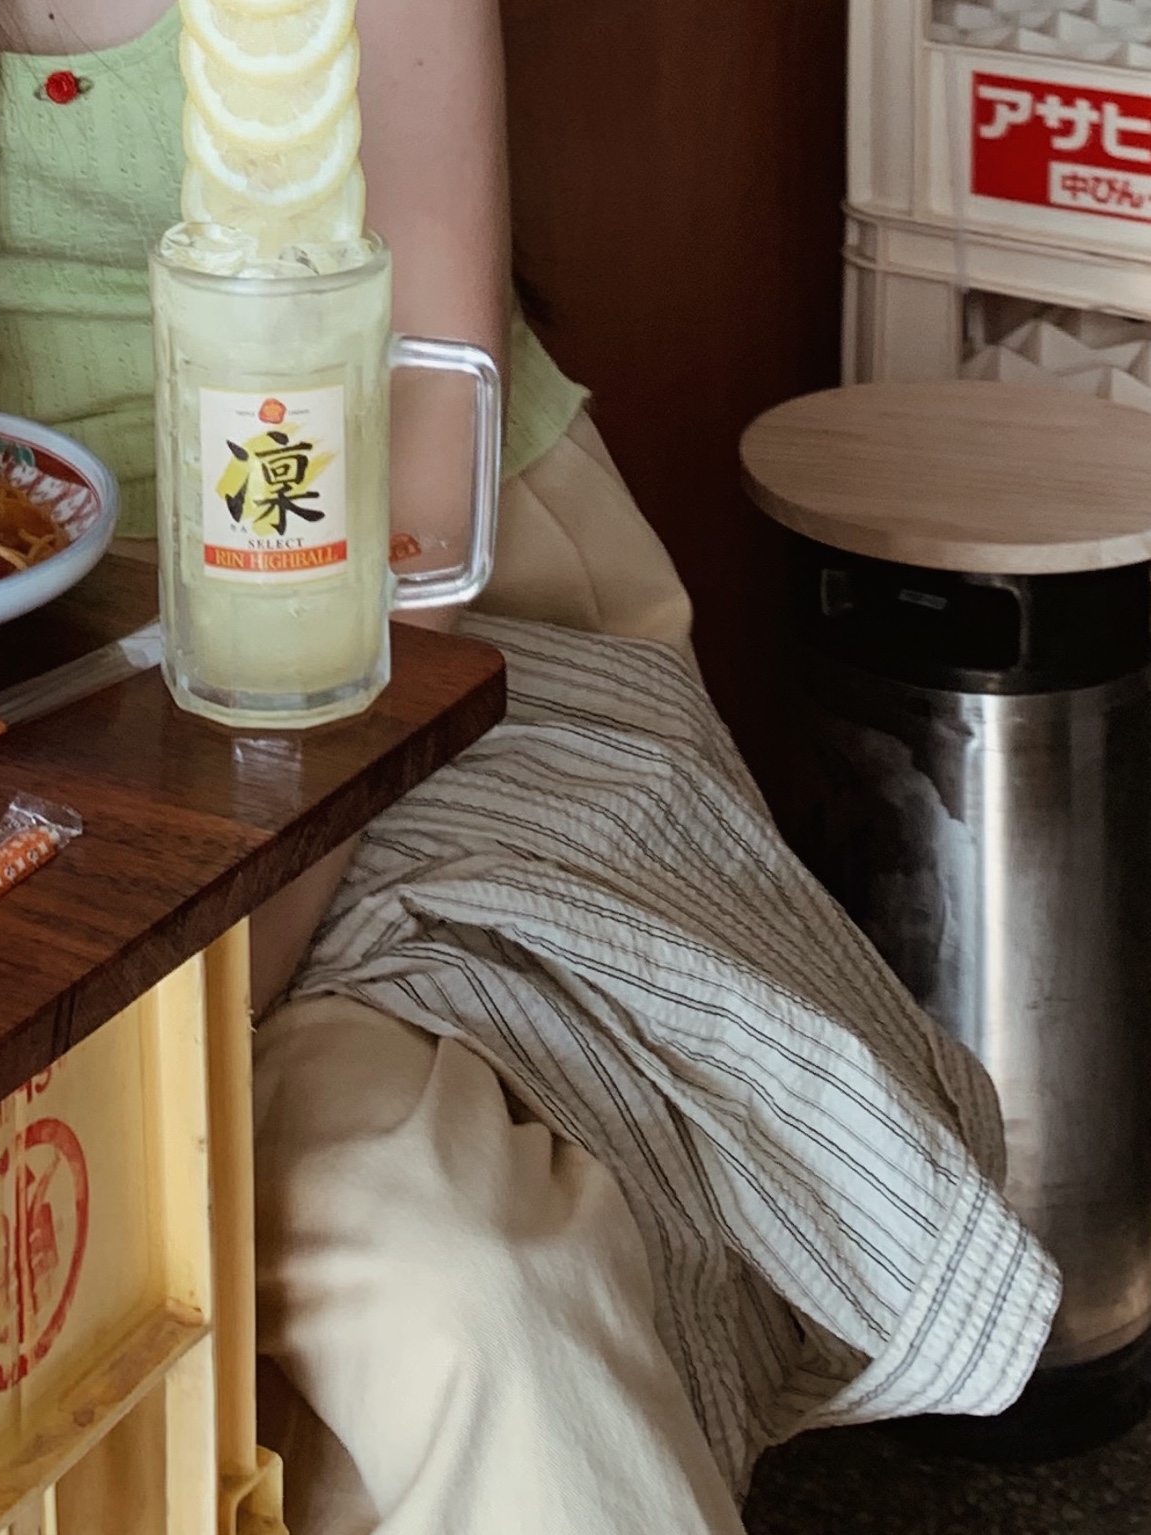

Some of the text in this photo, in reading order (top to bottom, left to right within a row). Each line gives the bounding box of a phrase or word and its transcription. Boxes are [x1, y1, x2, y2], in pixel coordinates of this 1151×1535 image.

[977, 84, 1151, 163] アサヒ
[247, 538, 305, 550] SELECT
[214, 548, 245, 569] RIN
